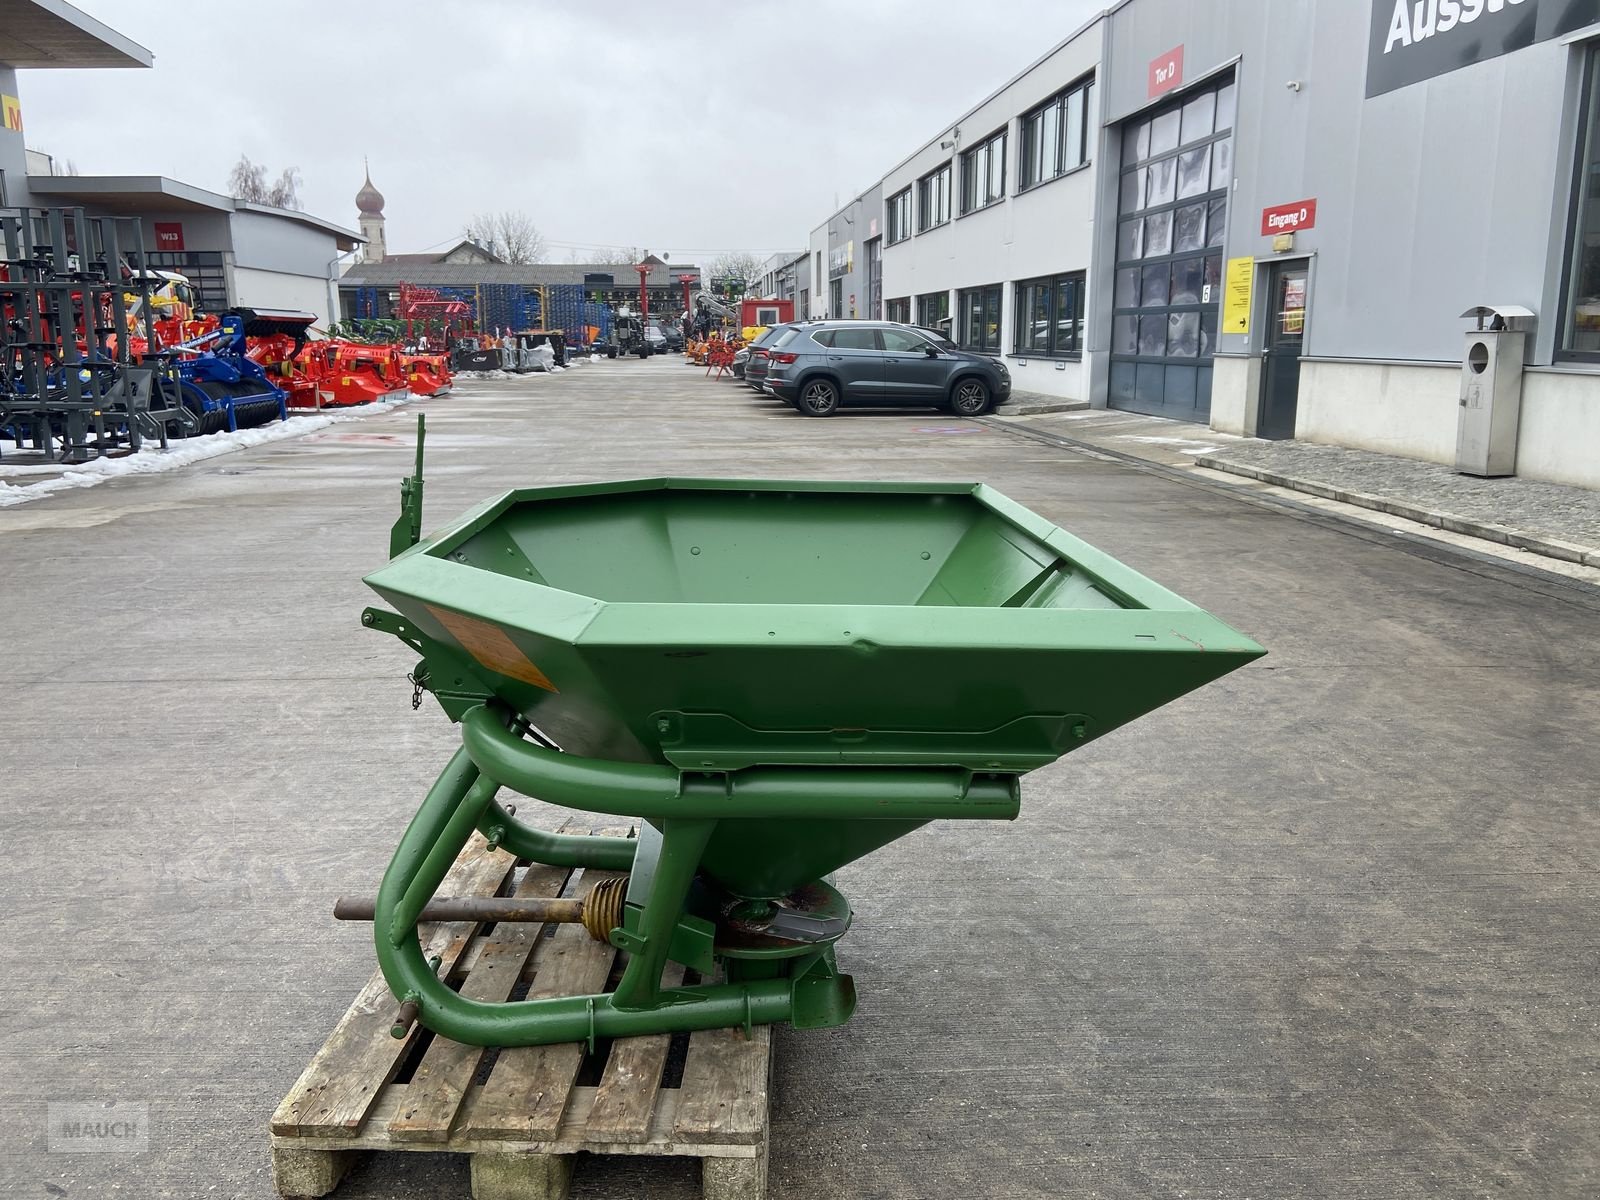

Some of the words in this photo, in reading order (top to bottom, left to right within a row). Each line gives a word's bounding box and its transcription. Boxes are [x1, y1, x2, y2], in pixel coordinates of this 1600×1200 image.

[1155, 68, 1168, 85] Tor
[1168, 61, 1175, 79] D
[1268, 212, 1299, 229] Eingang
[1300, 208, 1307, 222] D
[161, 232, 178, 241] W13
[1203, 286, 1209, 302] 6
